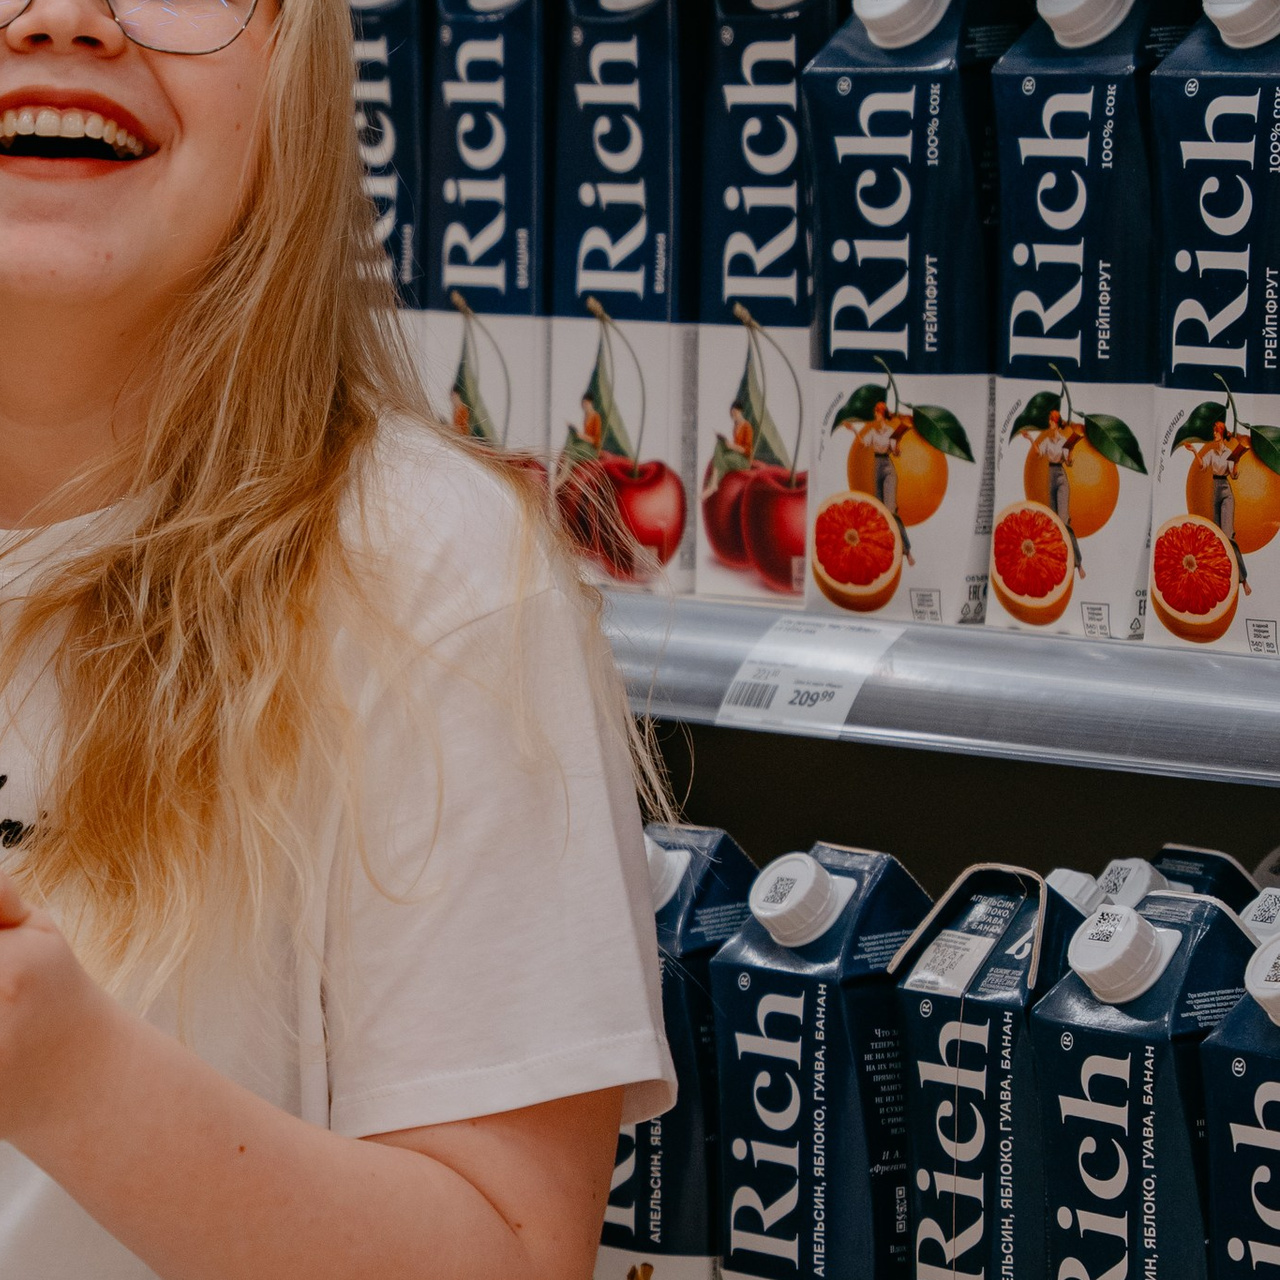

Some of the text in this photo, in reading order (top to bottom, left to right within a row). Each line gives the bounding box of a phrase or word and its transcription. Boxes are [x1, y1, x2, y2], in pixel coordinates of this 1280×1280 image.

[441, 33, 507, 296] Rich
[574, 33, 649, 301] Rich
[722, 33, 799, 306] Rich
[926, 117, 939, 167] 100%
[1102, 120, 1115, 169] 100%
[830, 84, 916, 361] Rich
[1009, 85, 1094, 368] Rich
[1171, 86, 1261, 378] Rich
[924, 254, 938, 352] ГРЕЙПФРУТ
[1097, 259, 1112, 360] ГРЕЙПФРУТ
[1264, 267, 1279, 369] ГРЕЙПФРУТ
[1000, 1010, 1013, 1070] БАНАН
[1142, 1045, 1155, 1106] БАНАН
[730, 990, 805, 1270] Rich
[813, 983, 828, 1278] АПЕЛЬСИН, ЯБЛОКО, ГУАВА, БАНАН
[999, 1074, 1014, 1133] ГУАВА,
[1142, 1109, 1156, 1172] ГУАВА,
[648, 1147, 663, 1244] АПЕЛЬСИН,
[999, 1135, 1015, 1210] ЯБЛОКО,
[1142, 1172, 1157, 1250] ЯБЛОКО,
